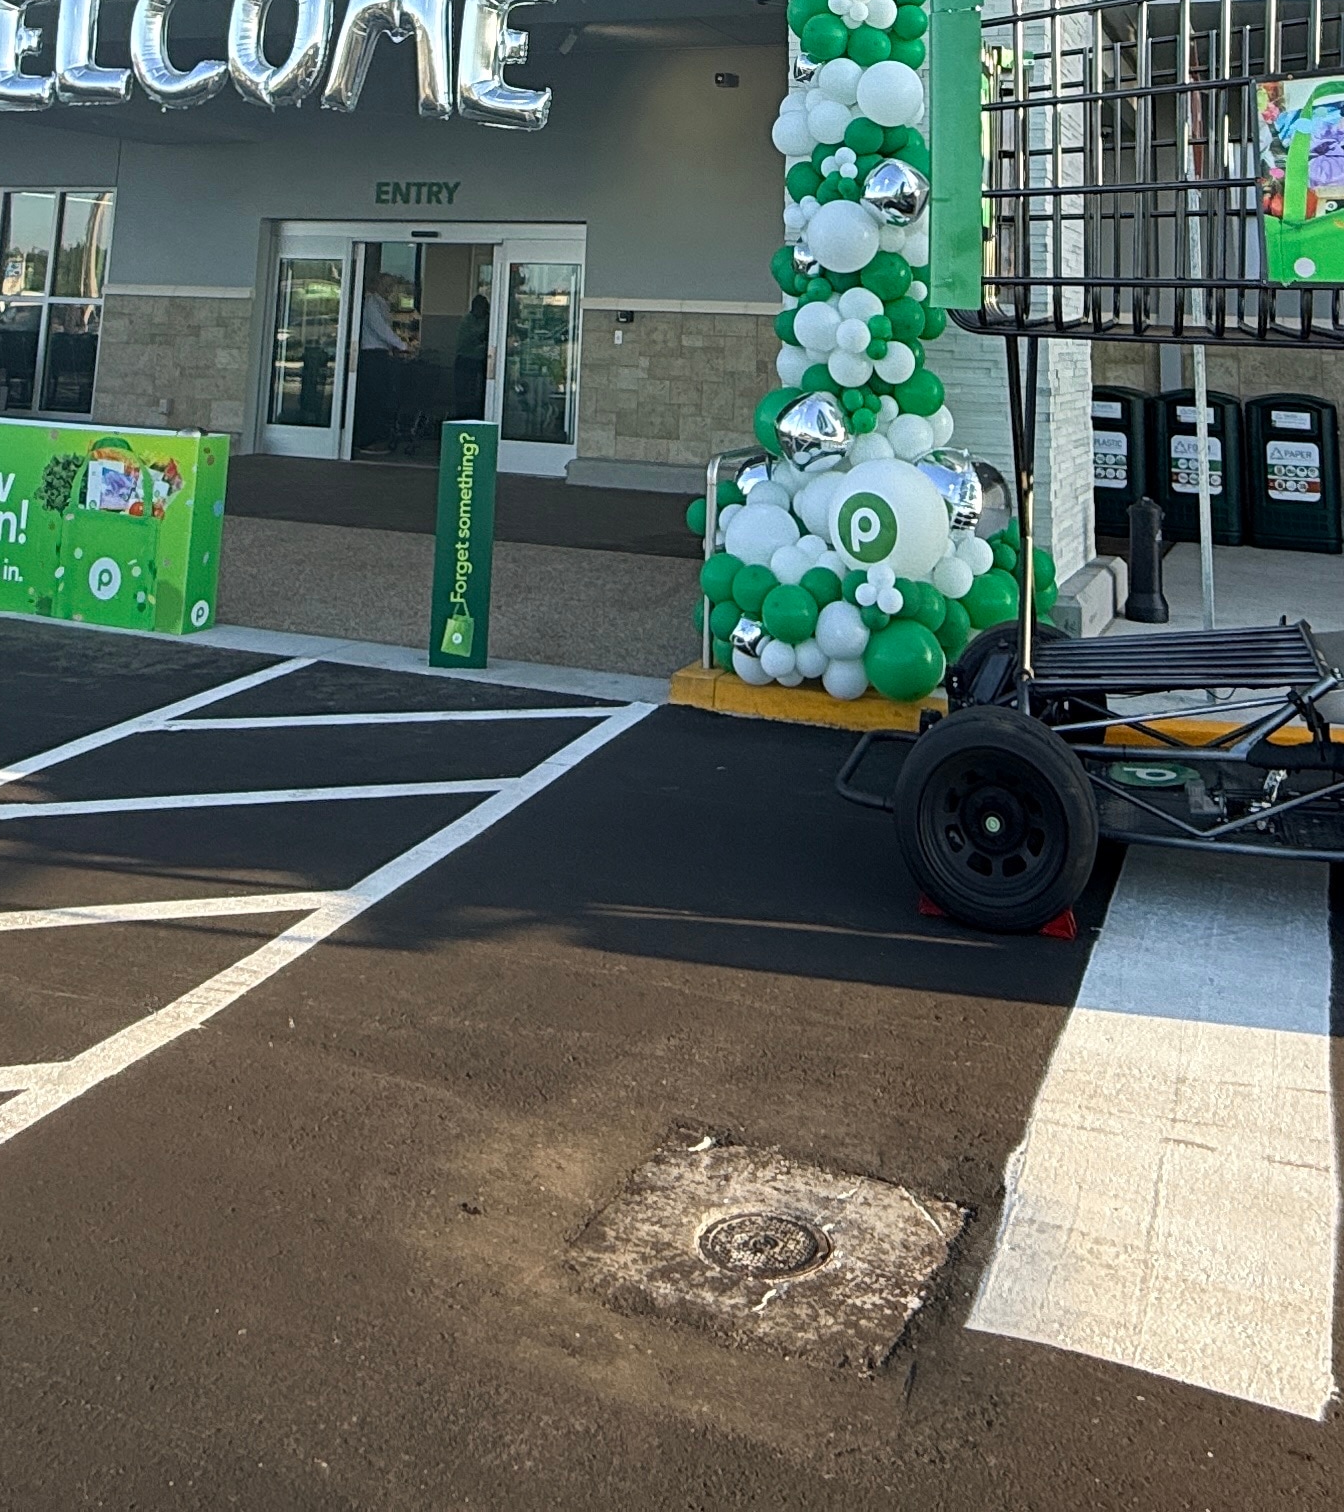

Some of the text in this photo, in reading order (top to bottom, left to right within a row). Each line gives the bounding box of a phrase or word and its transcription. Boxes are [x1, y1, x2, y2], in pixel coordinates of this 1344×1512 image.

[375, 181, 461, 205] ENTRY
[1284, 450, 1312, 459] PAPER
[450, 432, 479, 603] Forget something?
[3, 558, 23, 583] in.
